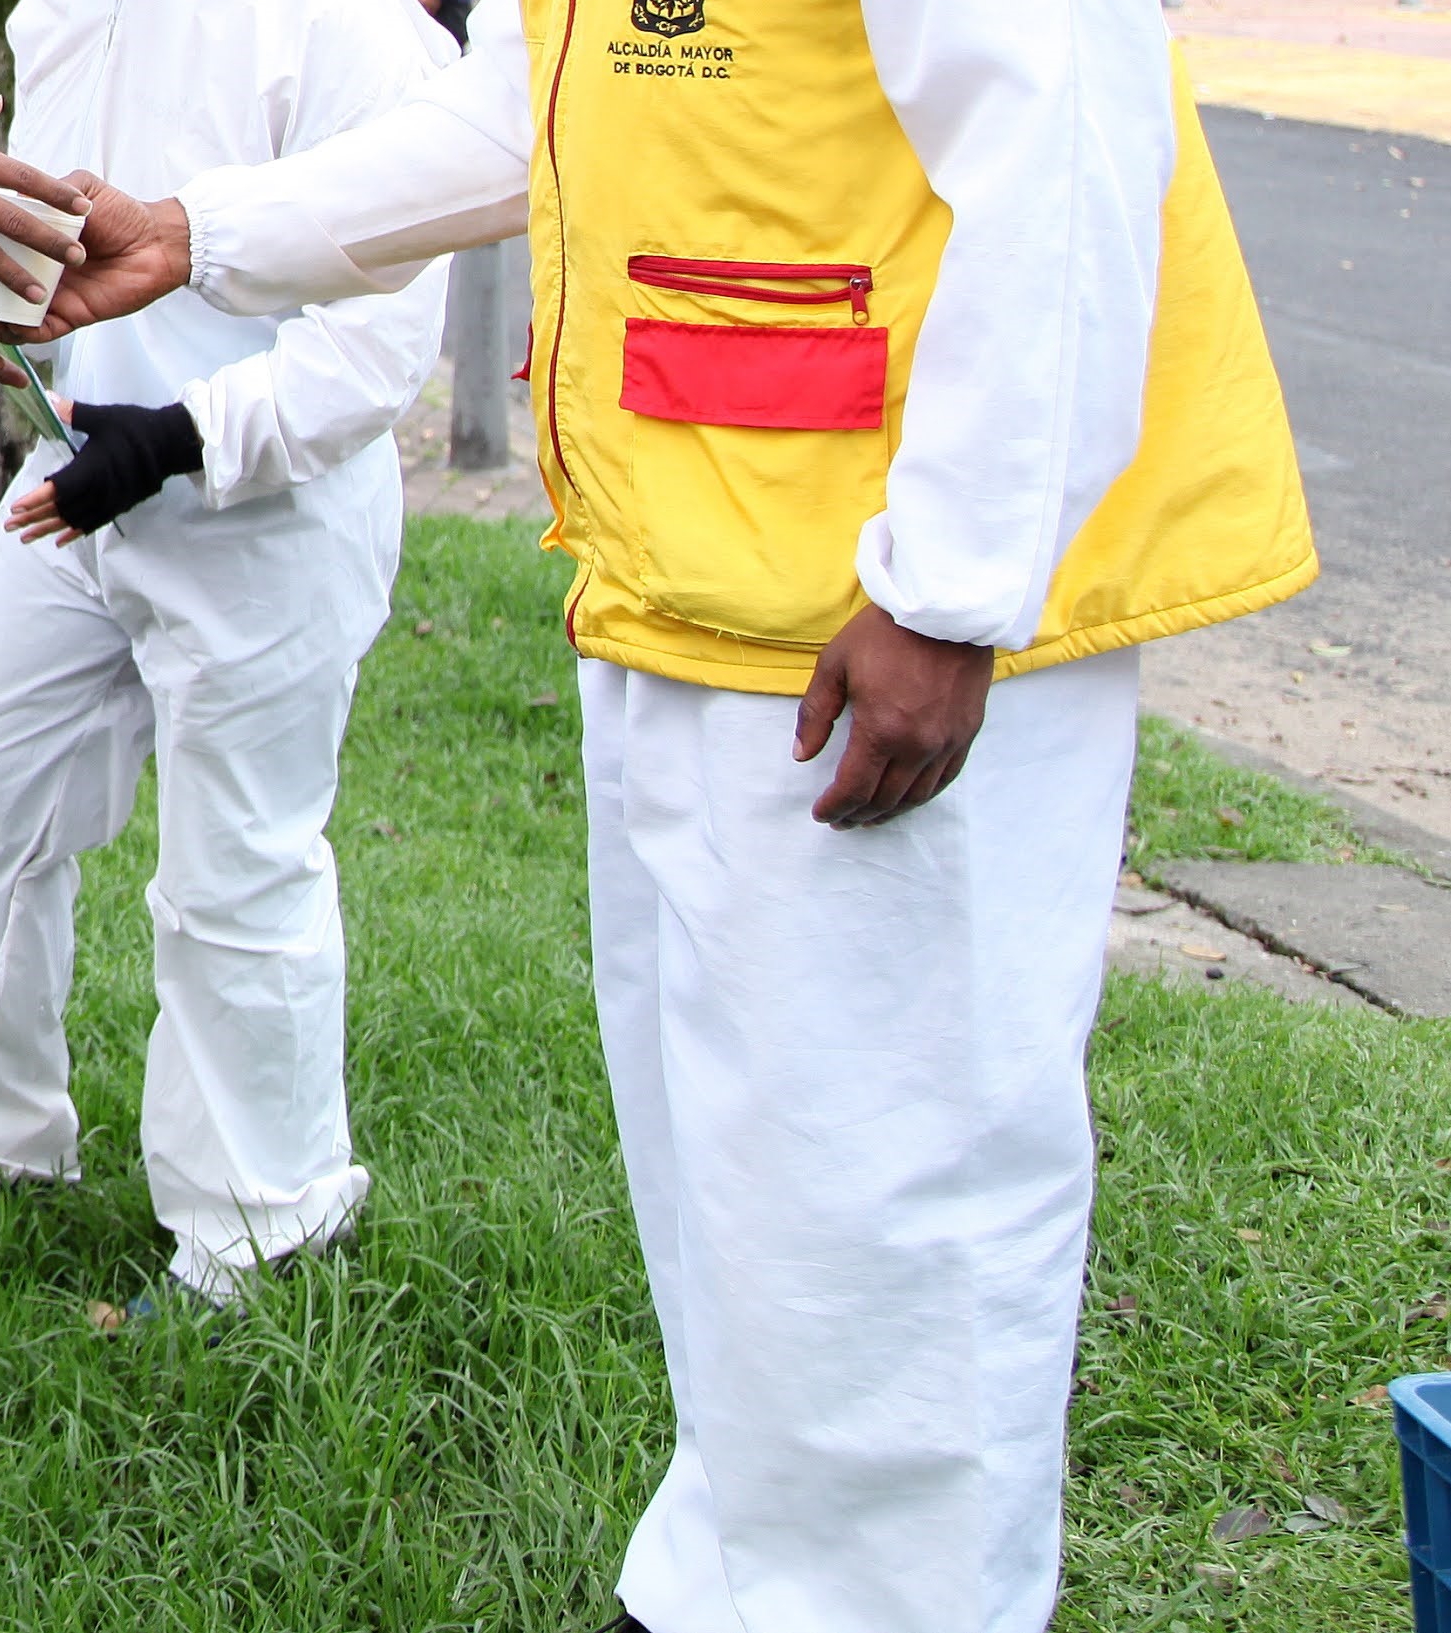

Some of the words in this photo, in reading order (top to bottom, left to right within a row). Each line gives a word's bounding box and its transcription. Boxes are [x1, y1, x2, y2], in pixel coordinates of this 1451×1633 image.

[607, 40, 672, 58] ALCALDÍA
[681, 46, 734, 62] MAYOR
[614, 62, 630, 74] DE
[636, 62, 695, 78] BOGOTÁ
[702, 67, 731, 79] D.C.
